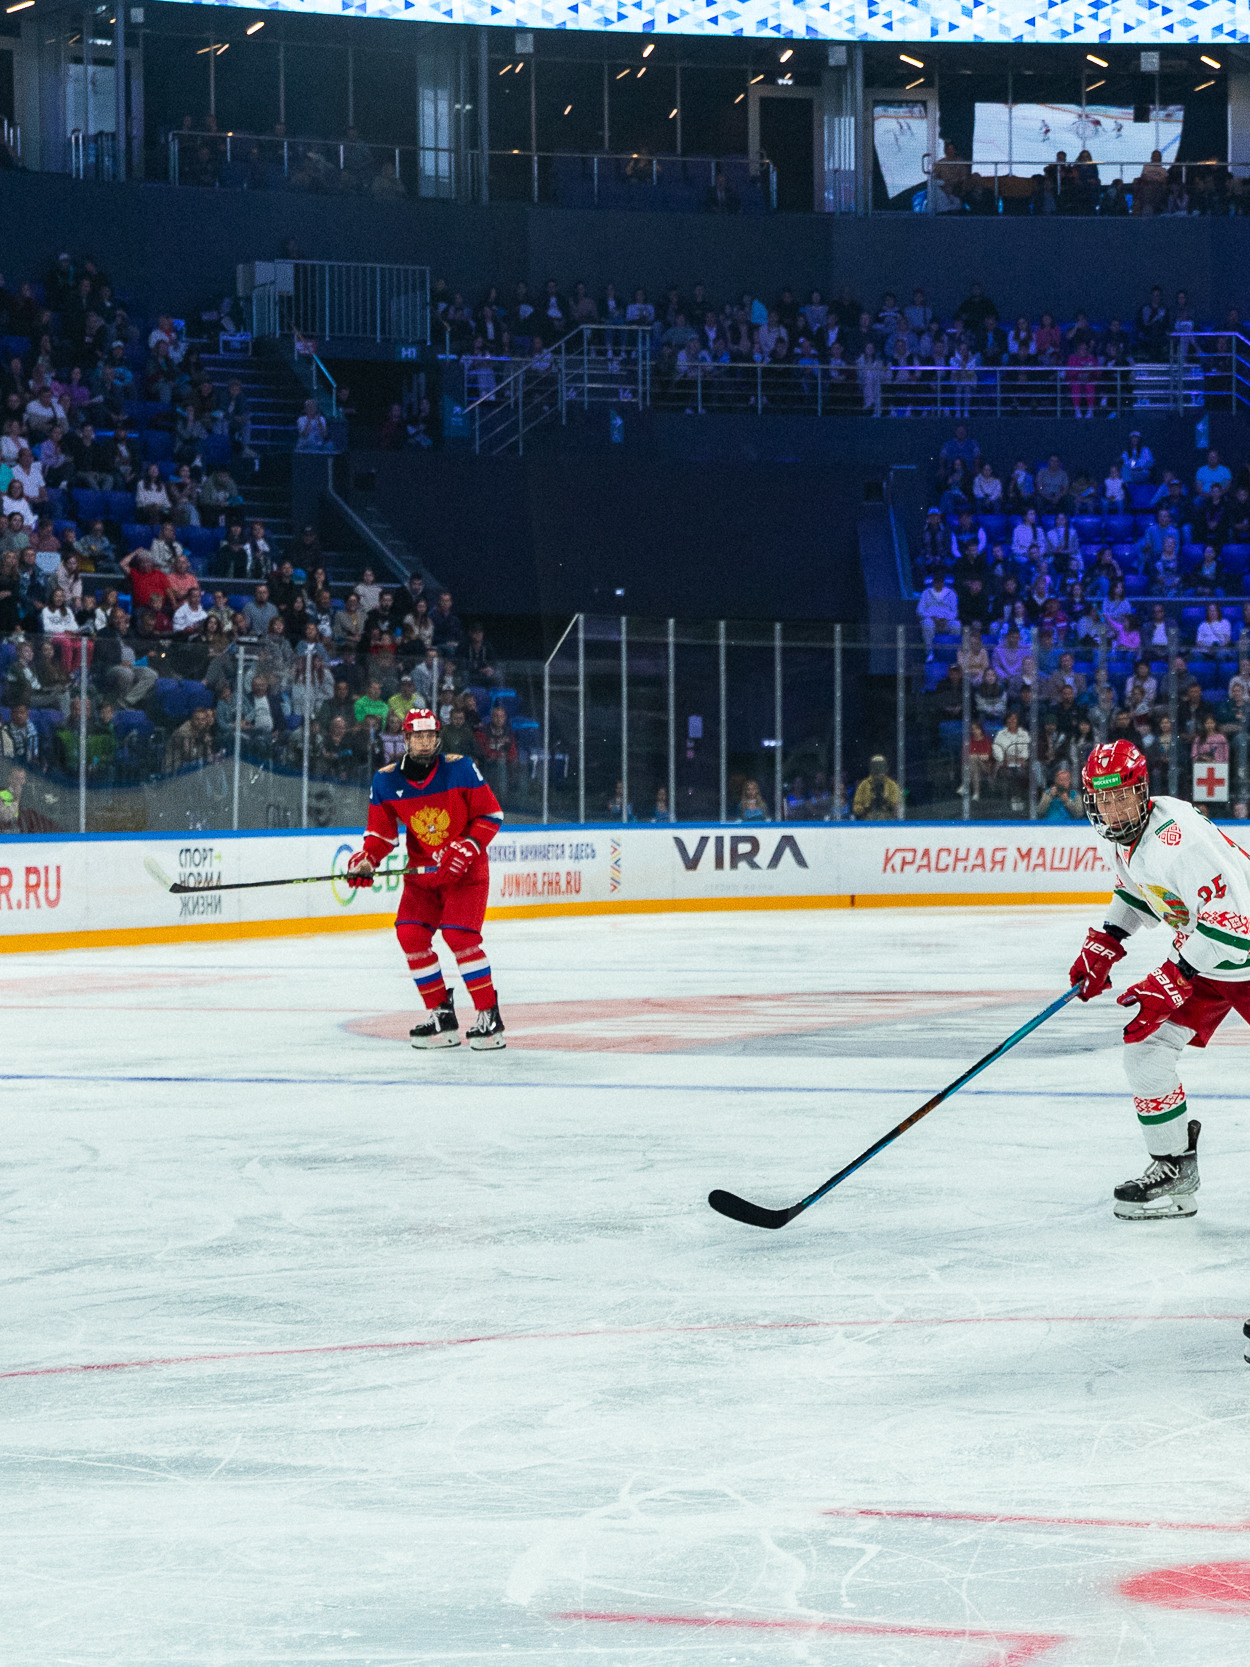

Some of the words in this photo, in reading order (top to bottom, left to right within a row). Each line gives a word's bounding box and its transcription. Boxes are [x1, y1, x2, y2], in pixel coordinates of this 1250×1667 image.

[179, 847, 214, 868] СПОРТ
[672, 835, 809, 871] VIRA
[882, 847, 1008, 873] КРАСНАЯ
[1012, 846, 1111, 873] МАШИН
[501, 871, 582, 898] JUNIOR.FHR.RU
[180, 894, 222, 917] ЖИЗНИ
